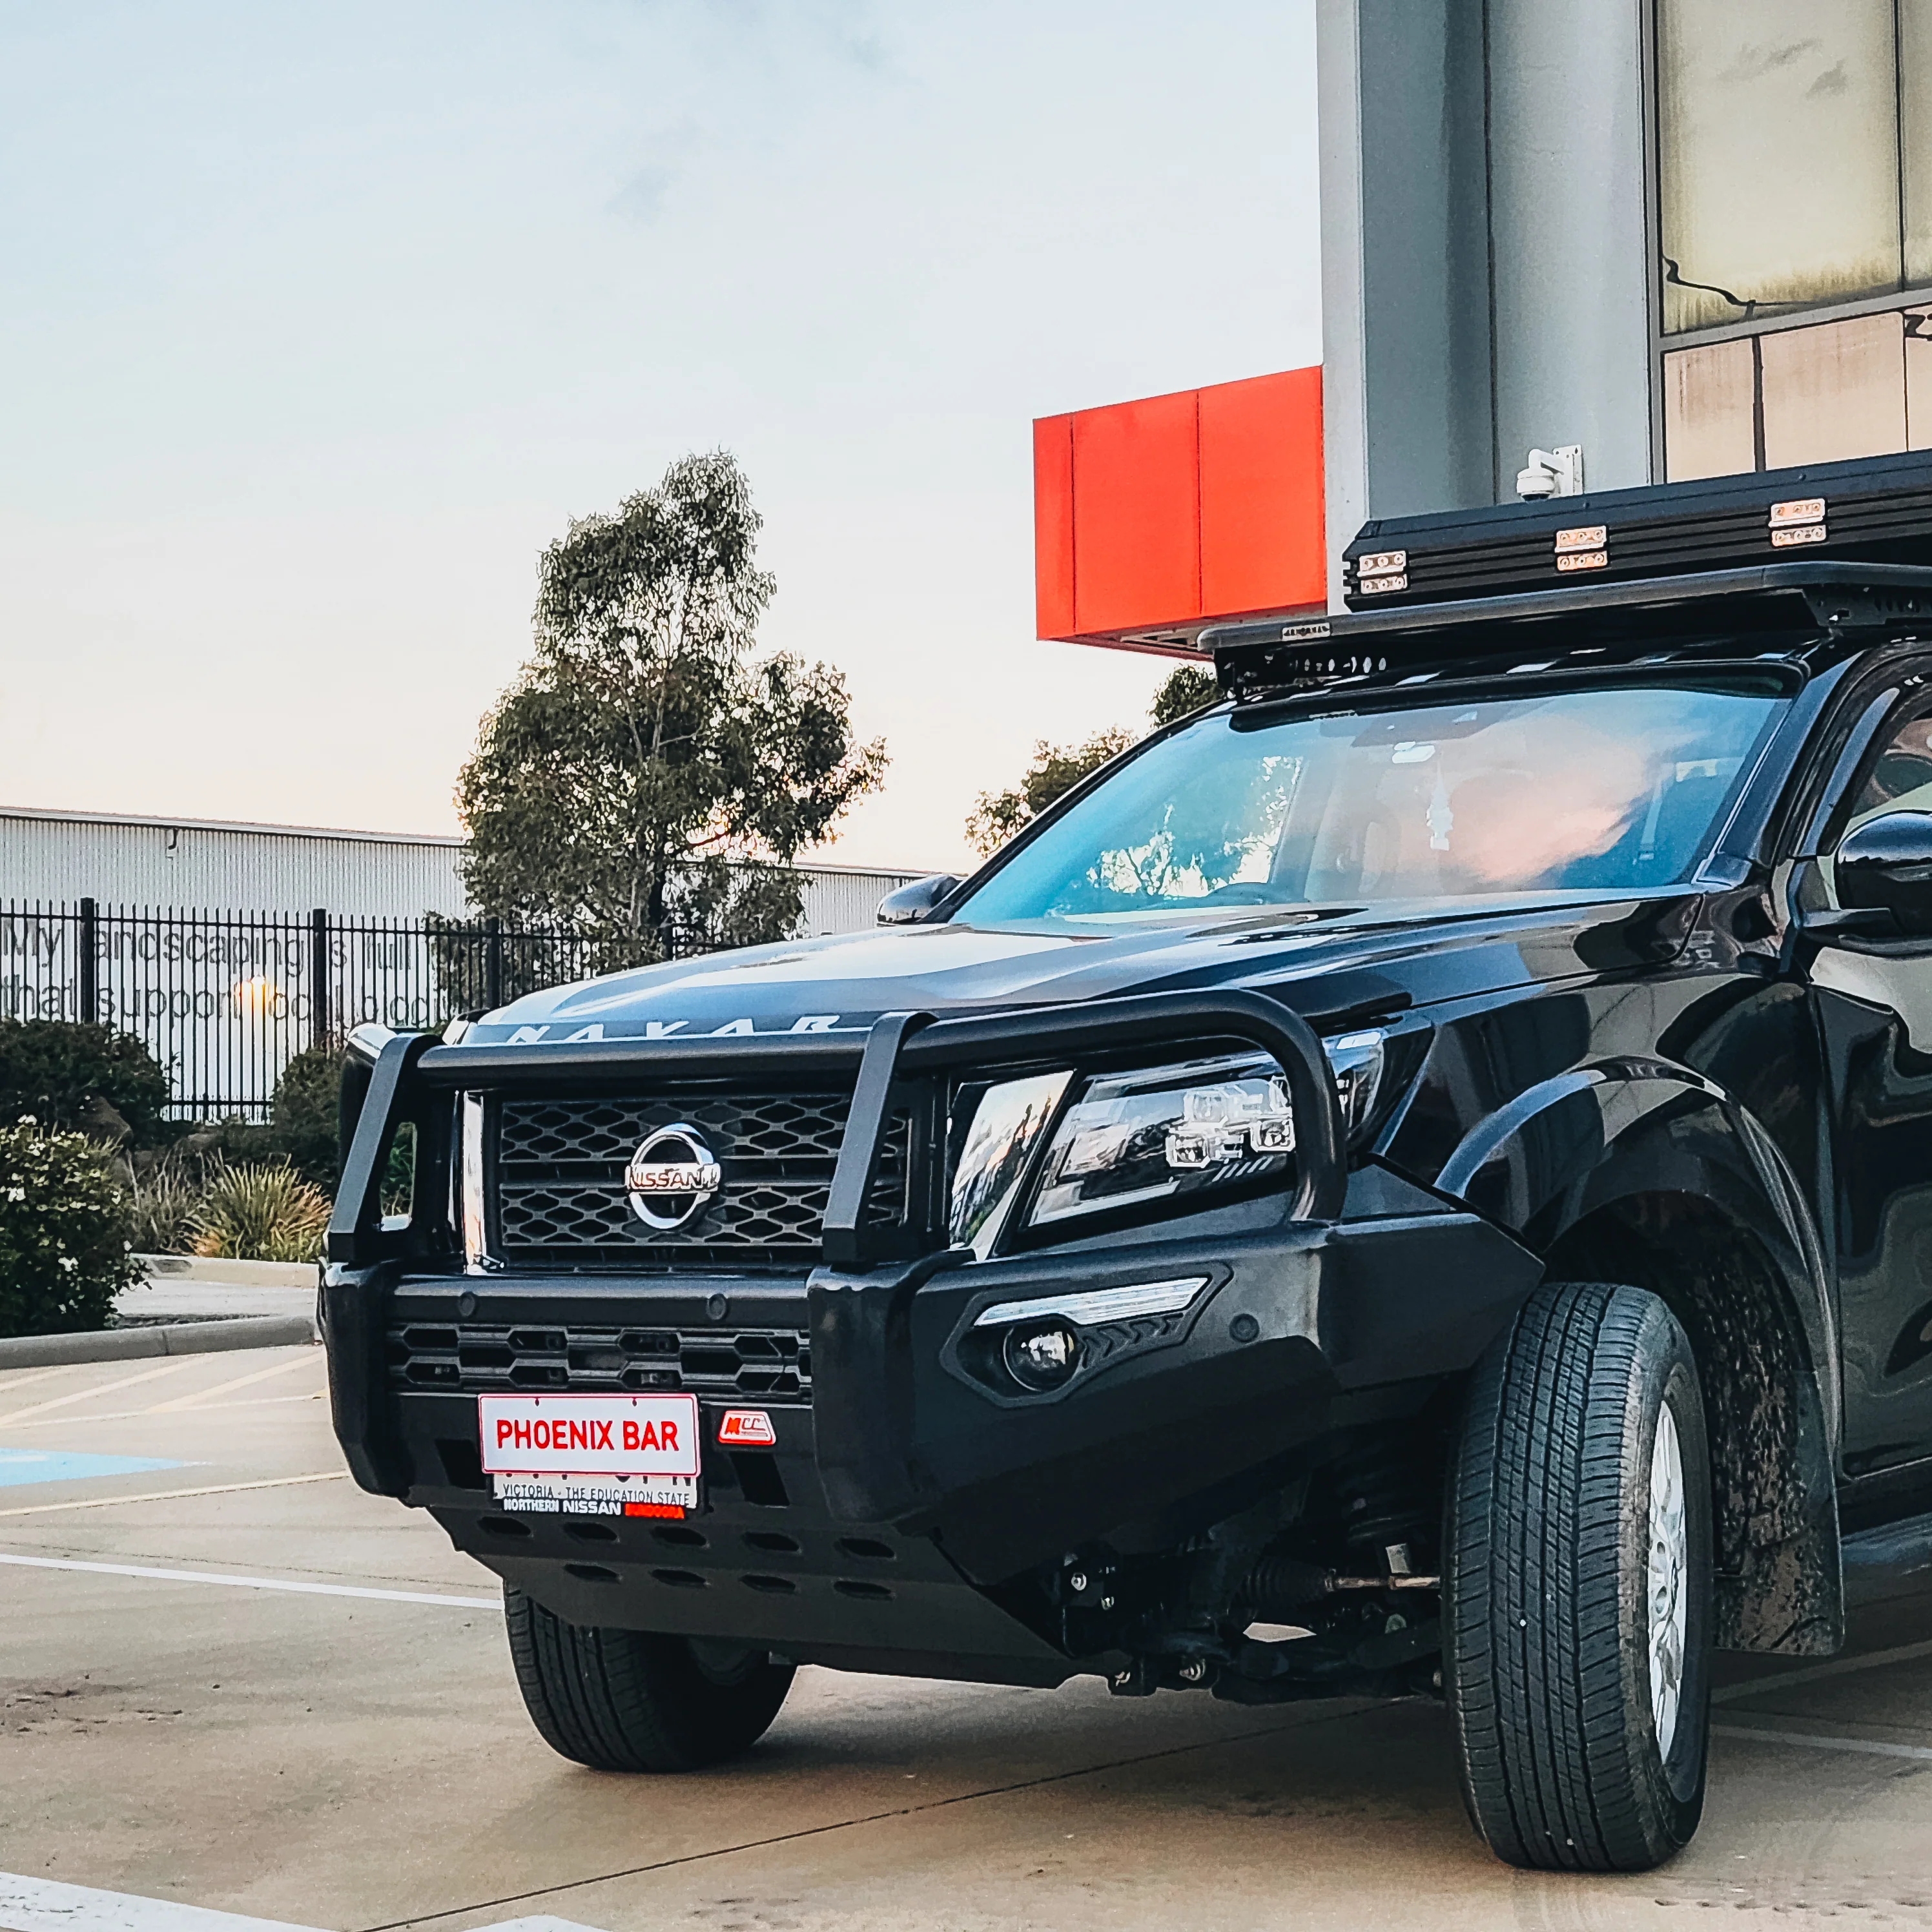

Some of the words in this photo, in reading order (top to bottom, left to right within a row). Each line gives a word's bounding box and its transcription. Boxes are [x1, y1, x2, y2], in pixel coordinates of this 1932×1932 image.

[81, 922, 305, 978] andscaping
[506, 1014, 842, 1045] NAVAR
[629, 1165, 705, 1189] NISSAN
[497, 1419, 615, 1450] PHOENIX
[622, 1420, 680, 1451] BAR
[503, 1483, 554, 1499] VICTORIA
[565, 1486, 587, 1499] THE
[590, 1488, 653, 1503] EDUCATION
[657, 1491, 690, 1506] STATE
[562, 1499, 621, 1516] NISSAN
